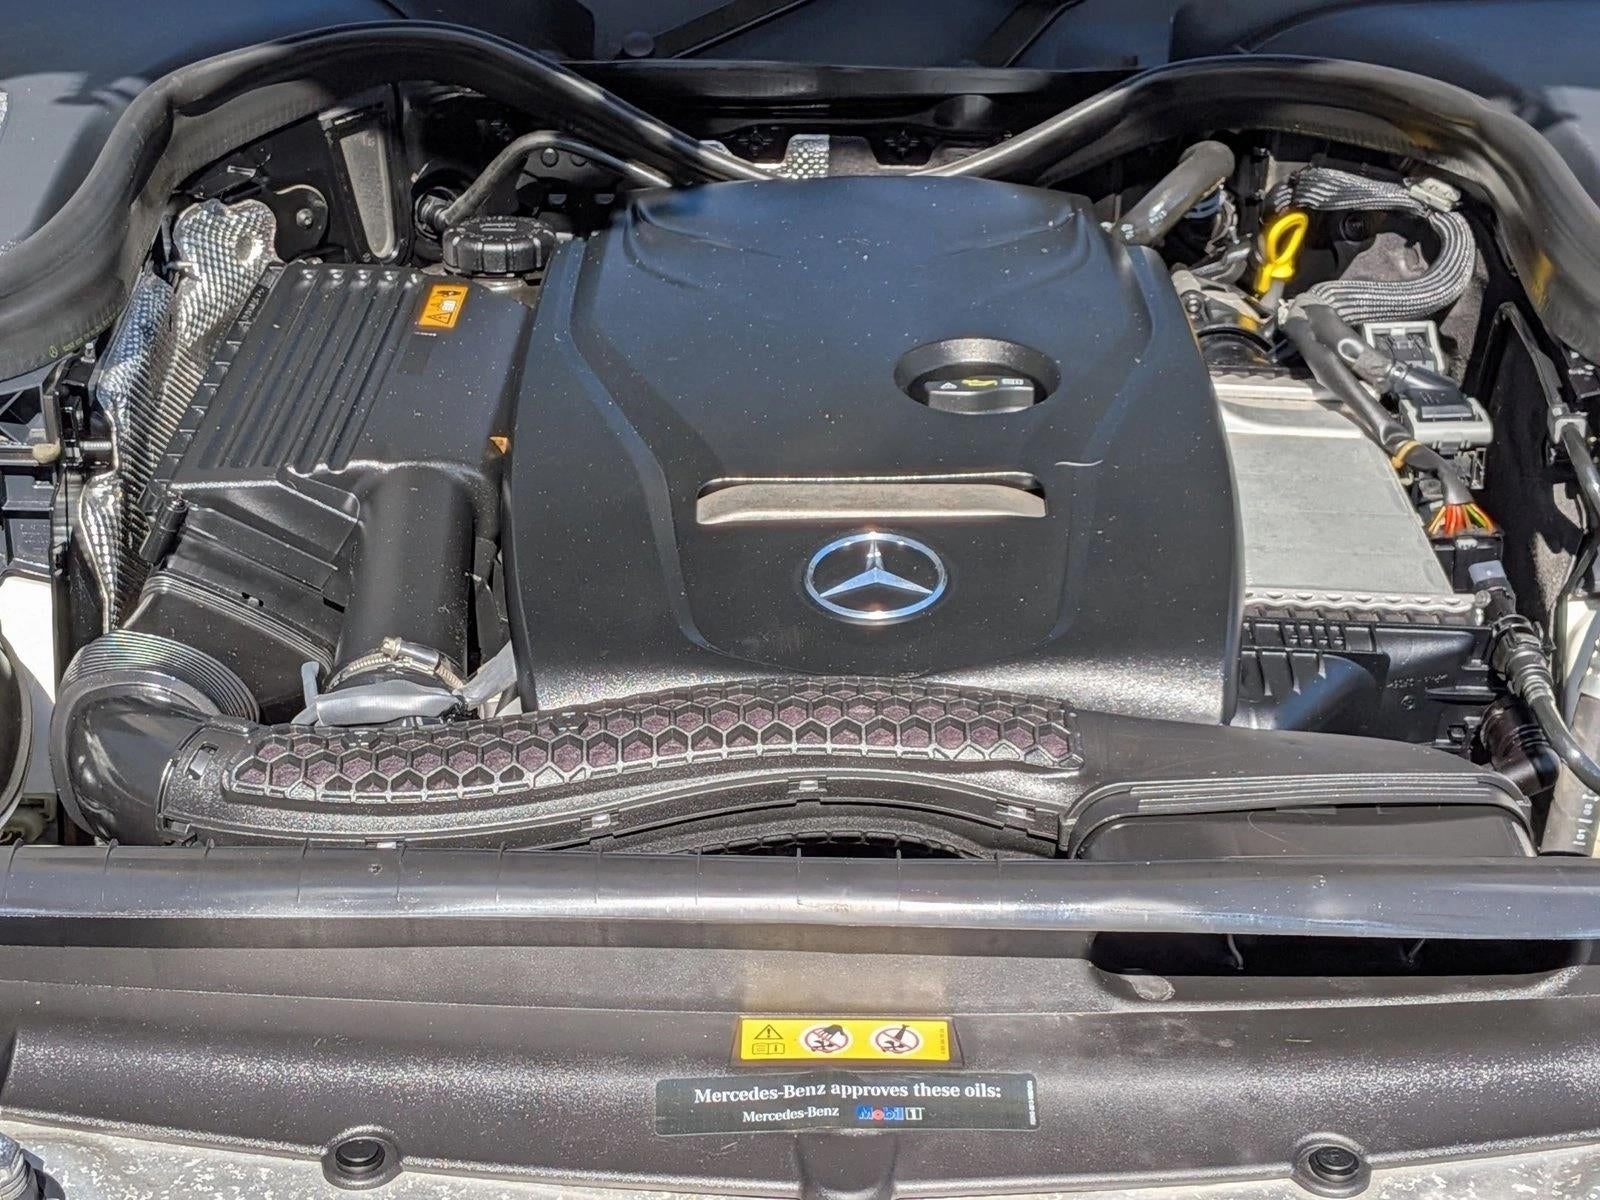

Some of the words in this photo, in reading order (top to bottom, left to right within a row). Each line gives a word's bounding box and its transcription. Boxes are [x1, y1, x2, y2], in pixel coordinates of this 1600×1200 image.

[694, 1084, 826, 1103] Mercedes-Benz
[830, 1083, 909, 1099] approves
[913, 1082, 961, 1098] these
[964, 1083, 1001, 1098] oils:
[742, 1106, 839, 1122] Mercedes-Benz
[857, 1105, 904, 1121] Mobil
